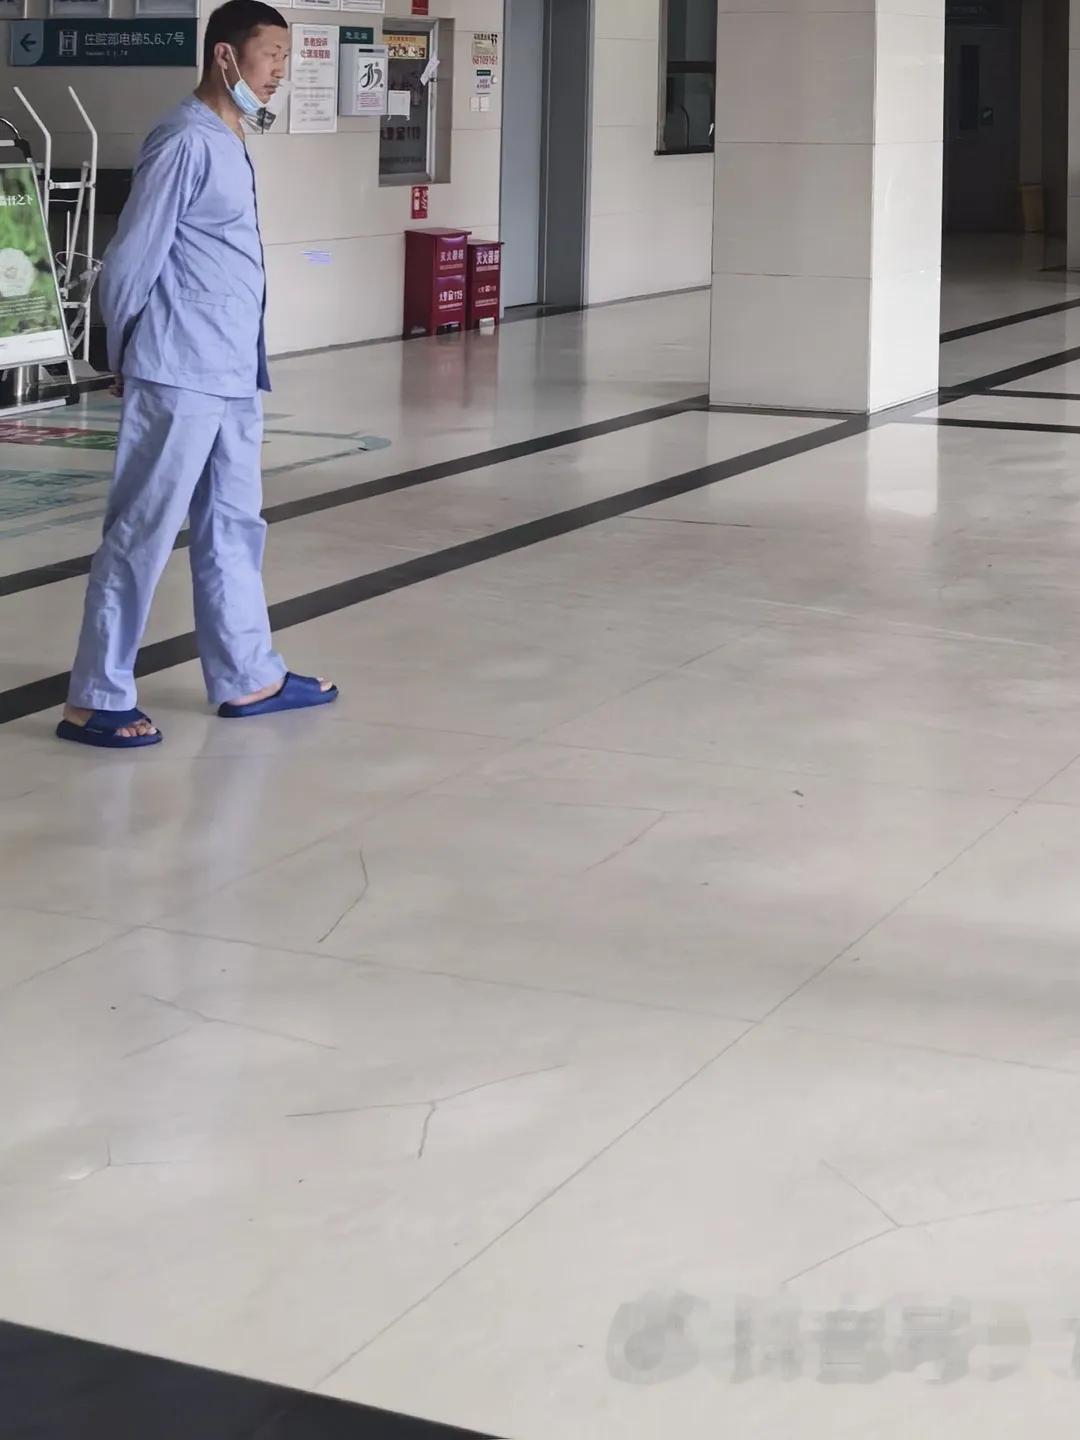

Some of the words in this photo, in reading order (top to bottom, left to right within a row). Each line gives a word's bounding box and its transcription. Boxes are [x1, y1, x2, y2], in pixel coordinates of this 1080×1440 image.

[84, 31, 185, 46] 住院部电梯5、6、7号
